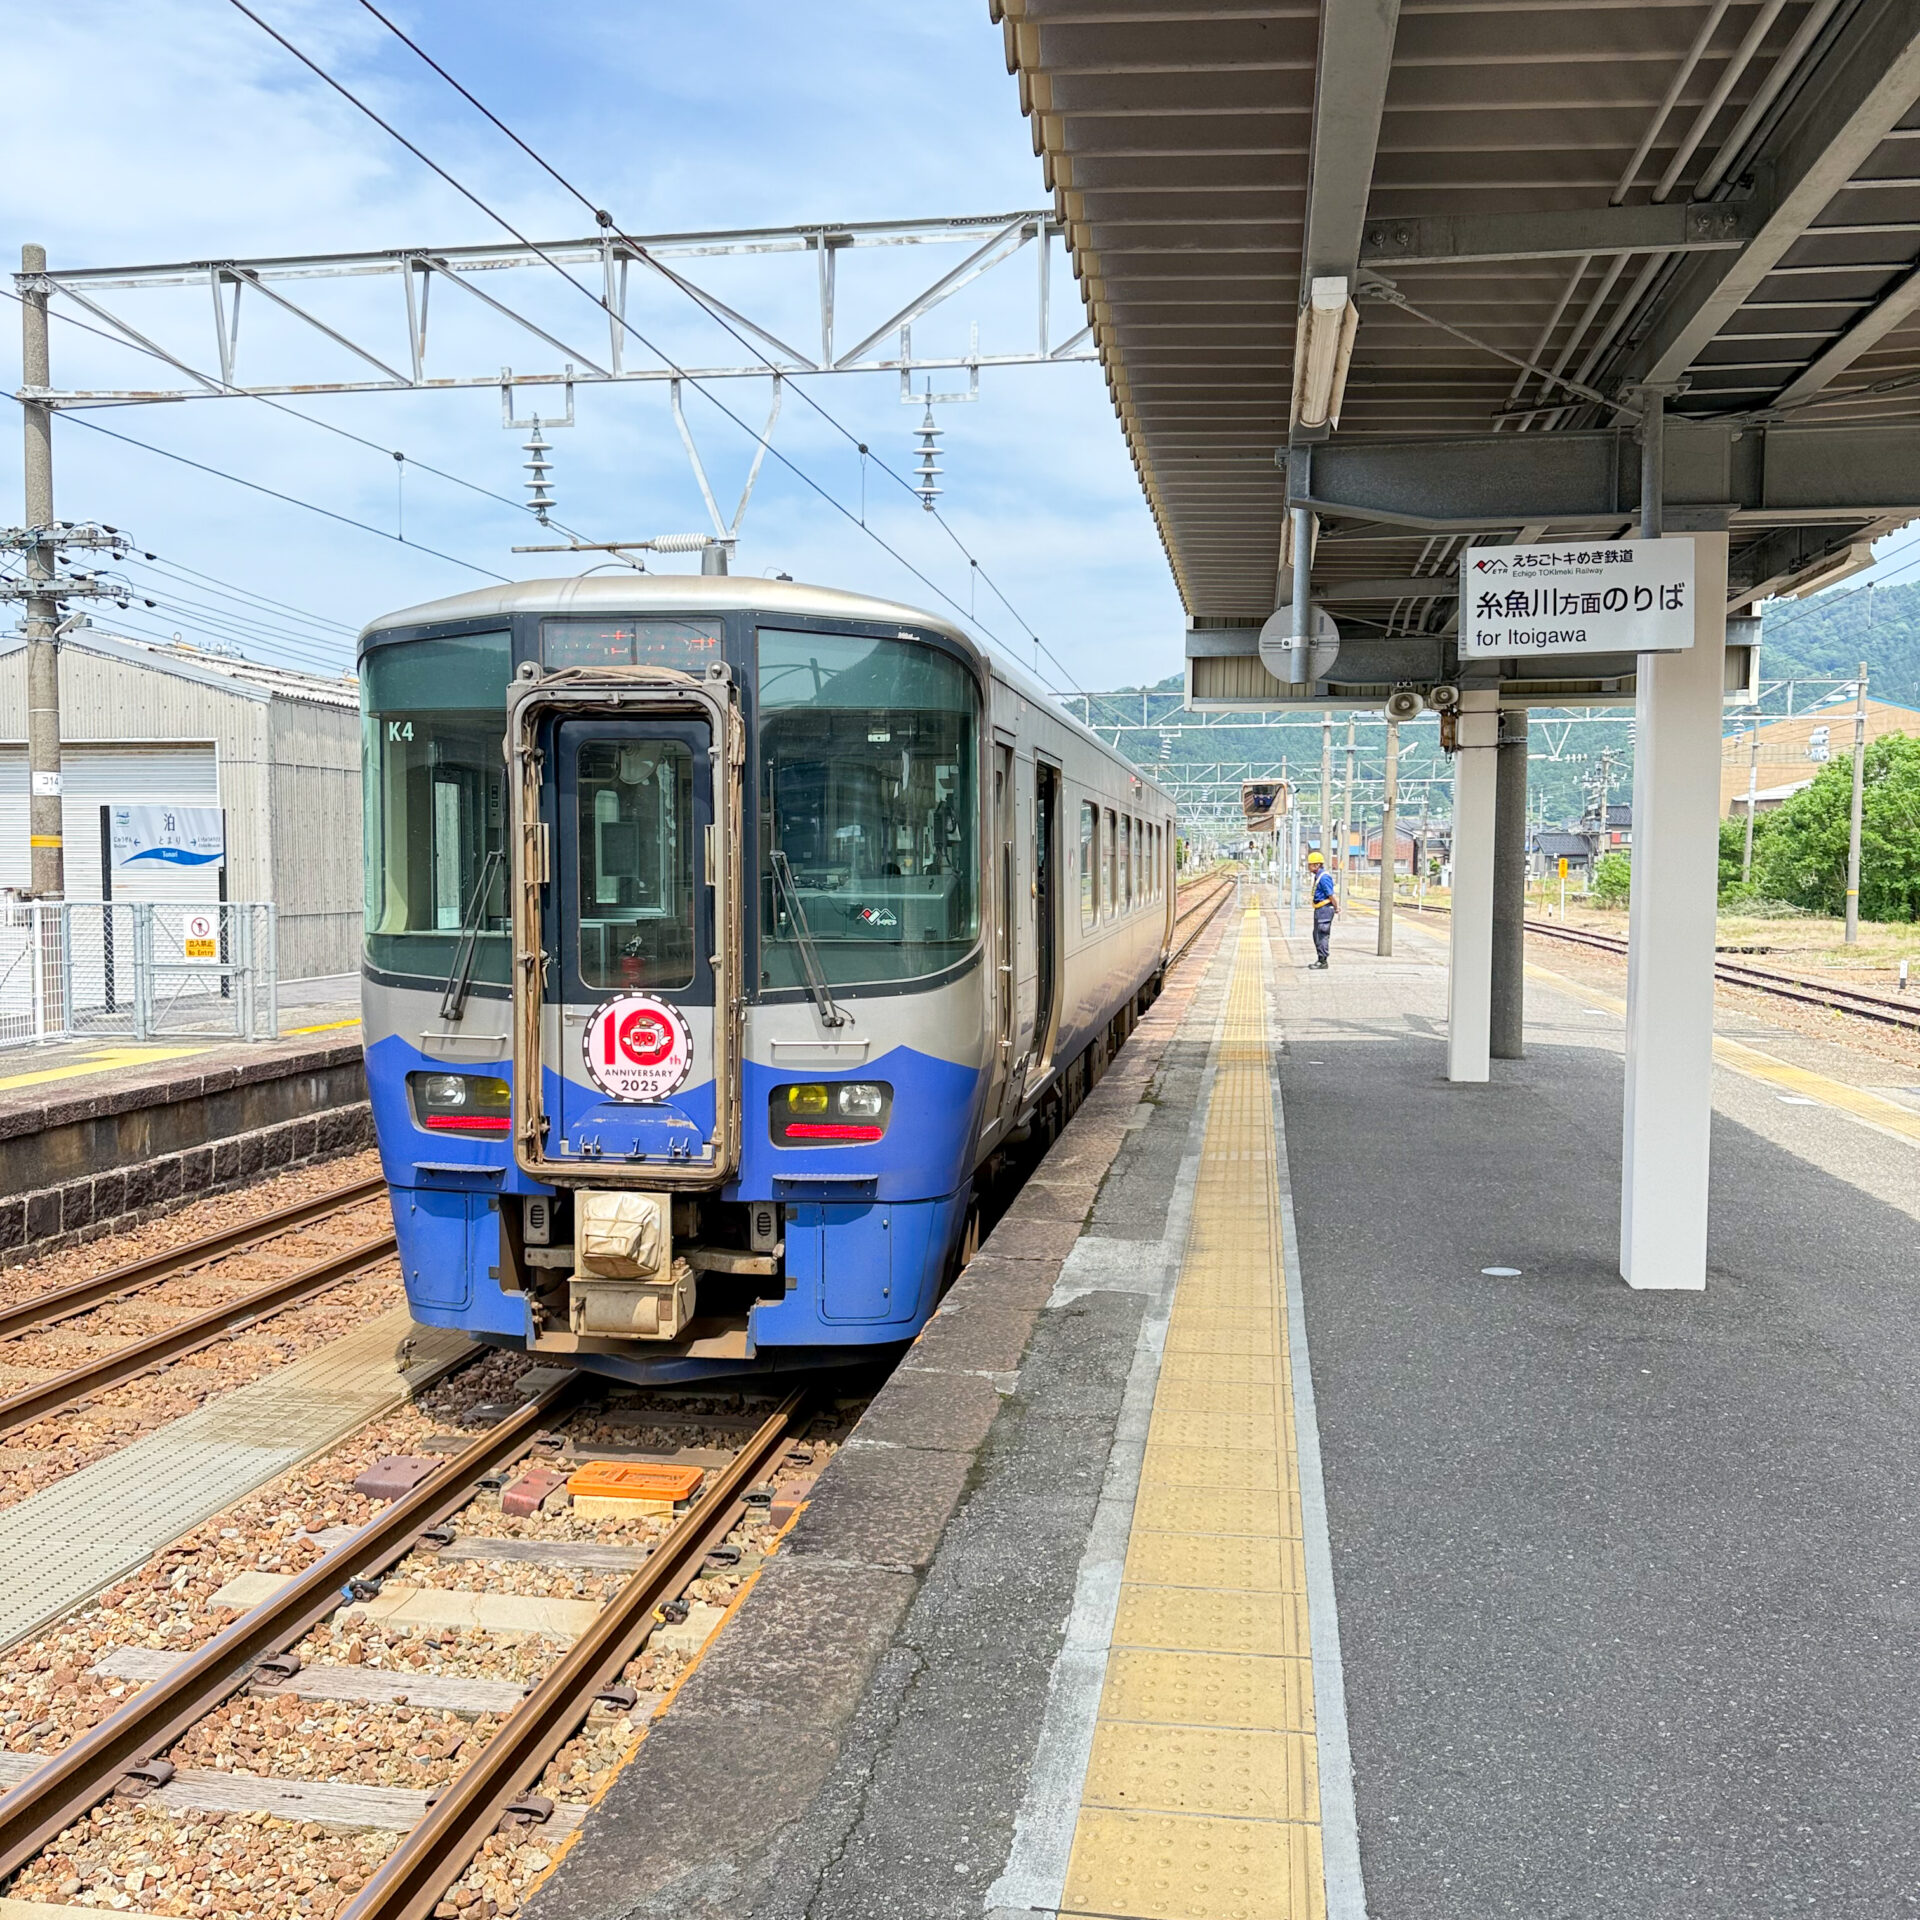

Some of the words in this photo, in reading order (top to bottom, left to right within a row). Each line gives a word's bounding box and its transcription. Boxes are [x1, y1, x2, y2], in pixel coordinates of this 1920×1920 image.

[1512, 549, 1634, 567] えちごトキめき鉄道
[1512, 569, 1537, 579] Echigo
[1575, 567, 1604, 576] Railway
[1476, 582, 1684, 619] 糸魚川方面のりば
[1476, 630, 1501, 647] for
[1508, 627, 1587, 648] Itoigawa
[388, 721, 414, 743] K4
[163, 813, 175, 832] 泊
[158, 836, 181, 845] とまり
[197, 949, 214, 957] Entry
[604, 1068, 674, 1078] ANNIVERSARY
[620, 1079, 659, 1092] 2025
